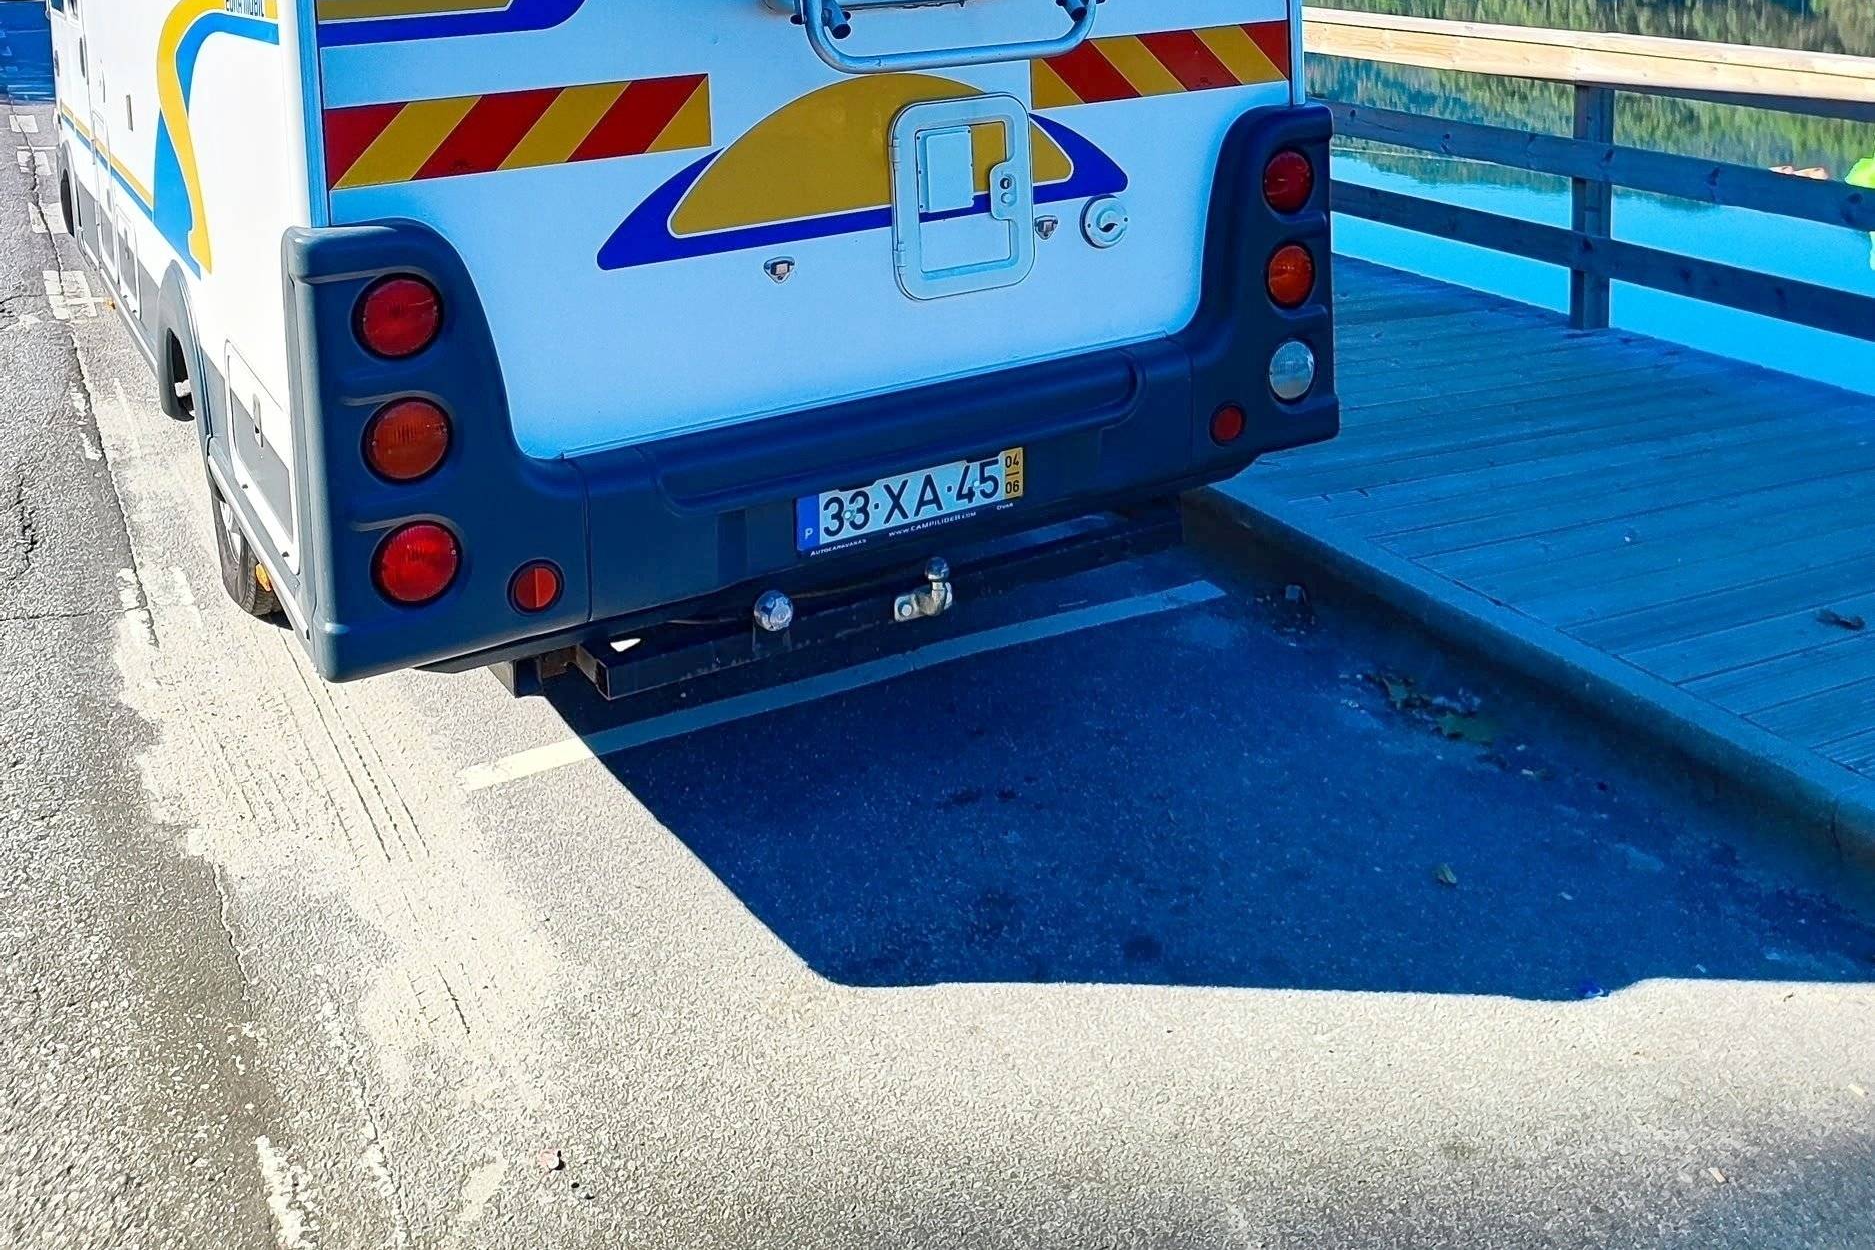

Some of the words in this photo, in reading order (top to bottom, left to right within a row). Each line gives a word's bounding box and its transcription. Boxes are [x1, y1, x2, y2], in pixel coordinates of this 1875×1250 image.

[1005, 452, 1020, 468] 04
[1005, 479, 1020, 495] 06
[804, 527, 814, 540] P
